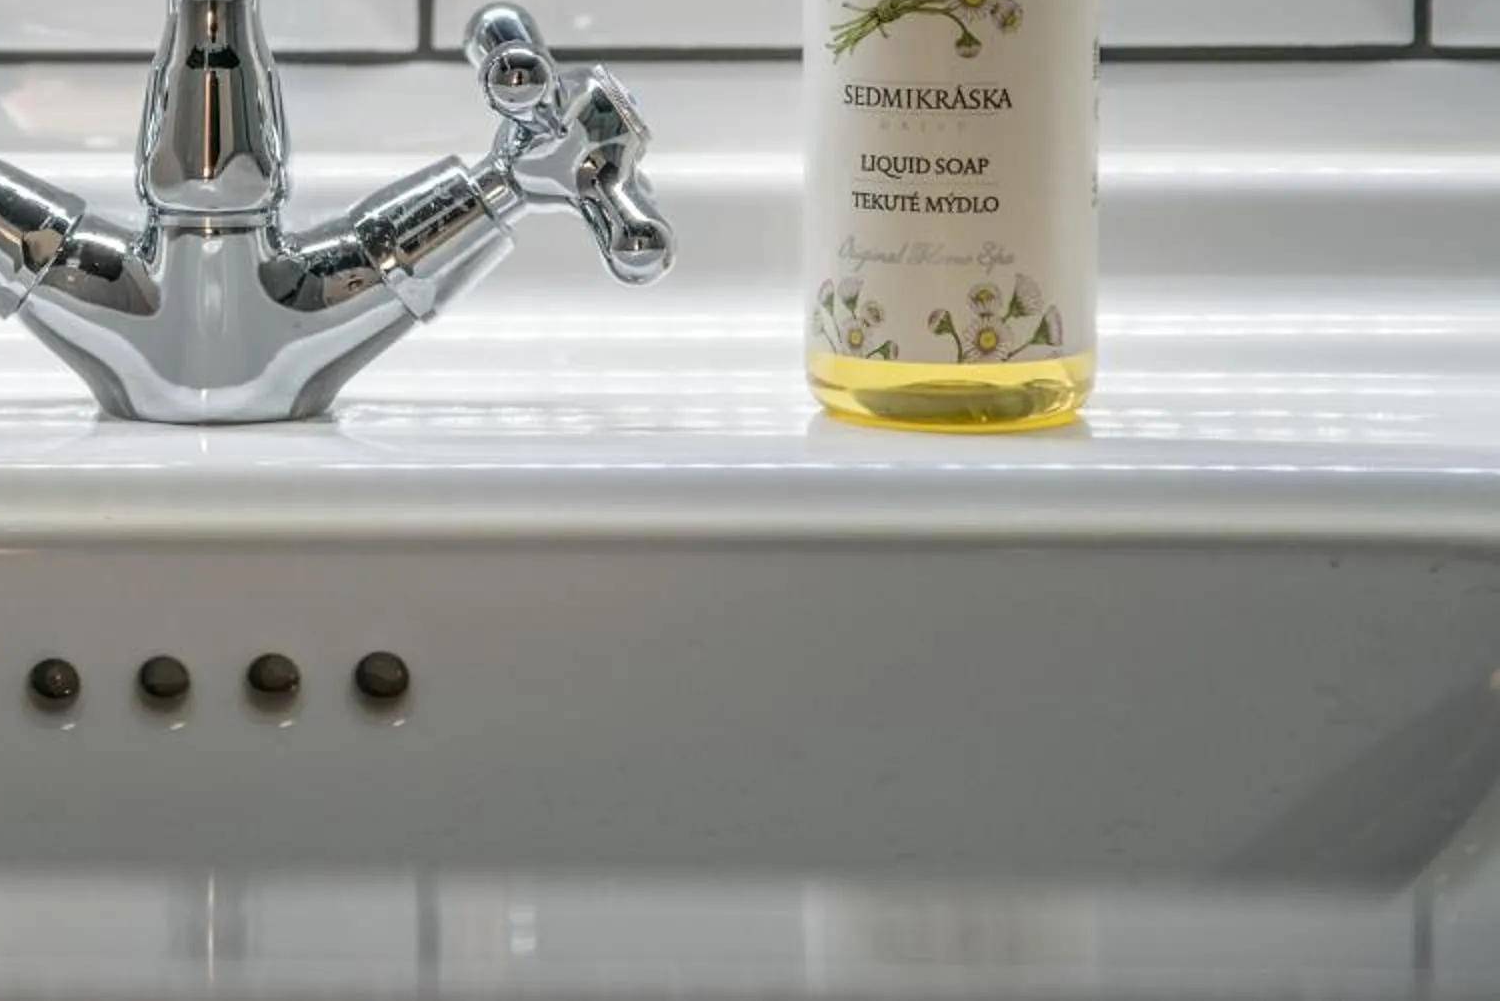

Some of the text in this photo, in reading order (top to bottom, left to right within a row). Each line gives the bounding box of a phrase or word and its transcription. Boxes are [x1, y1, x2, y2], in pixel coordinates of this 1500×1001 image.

[844, 84, 1013, 109] SEDMIKRÁSKA
[861, 154, 990, 179] LIQUID SOAP
[852, 191, 1000, 214] TEKUTÉ MÝDLO
